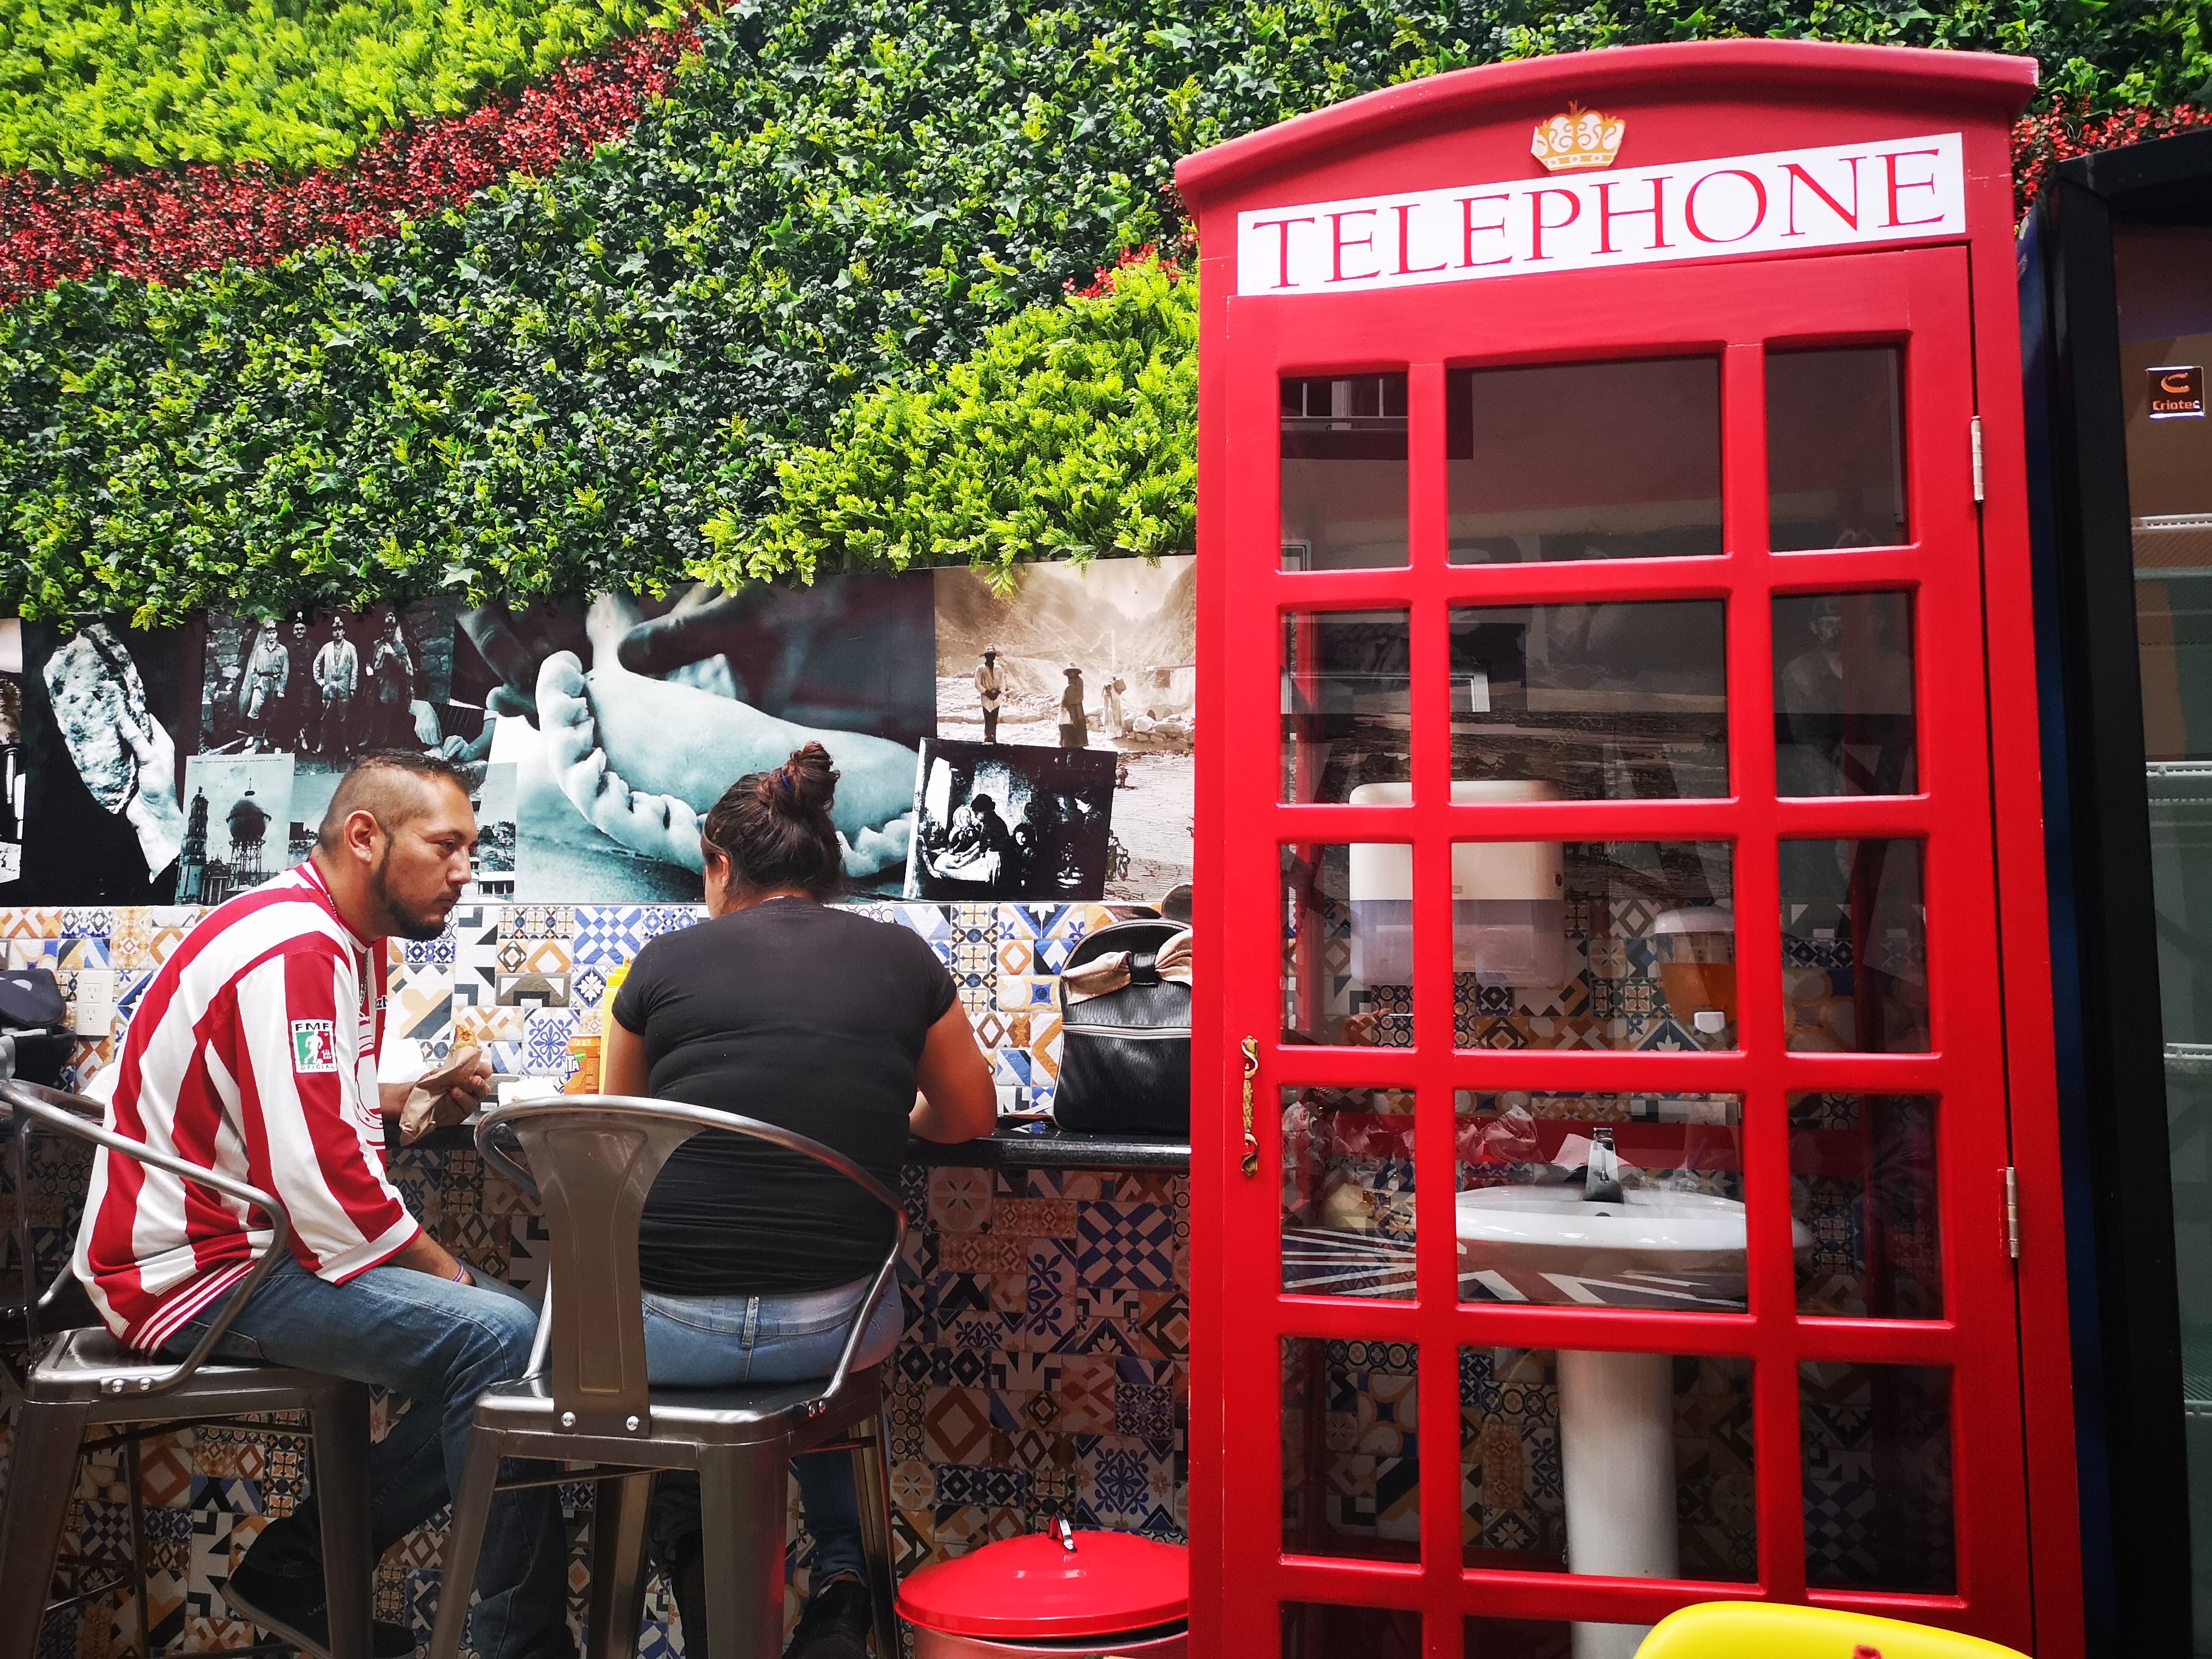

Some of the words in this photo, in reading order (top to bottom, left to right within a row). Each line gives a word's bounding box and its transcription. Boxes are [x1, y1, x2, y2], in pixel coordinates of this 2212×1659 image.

[1252, 149, 1945, 288] TELEPHONE
[2153, 400, 2200, 411] Criotec
[295, 1022, 329, 1031] FMF
